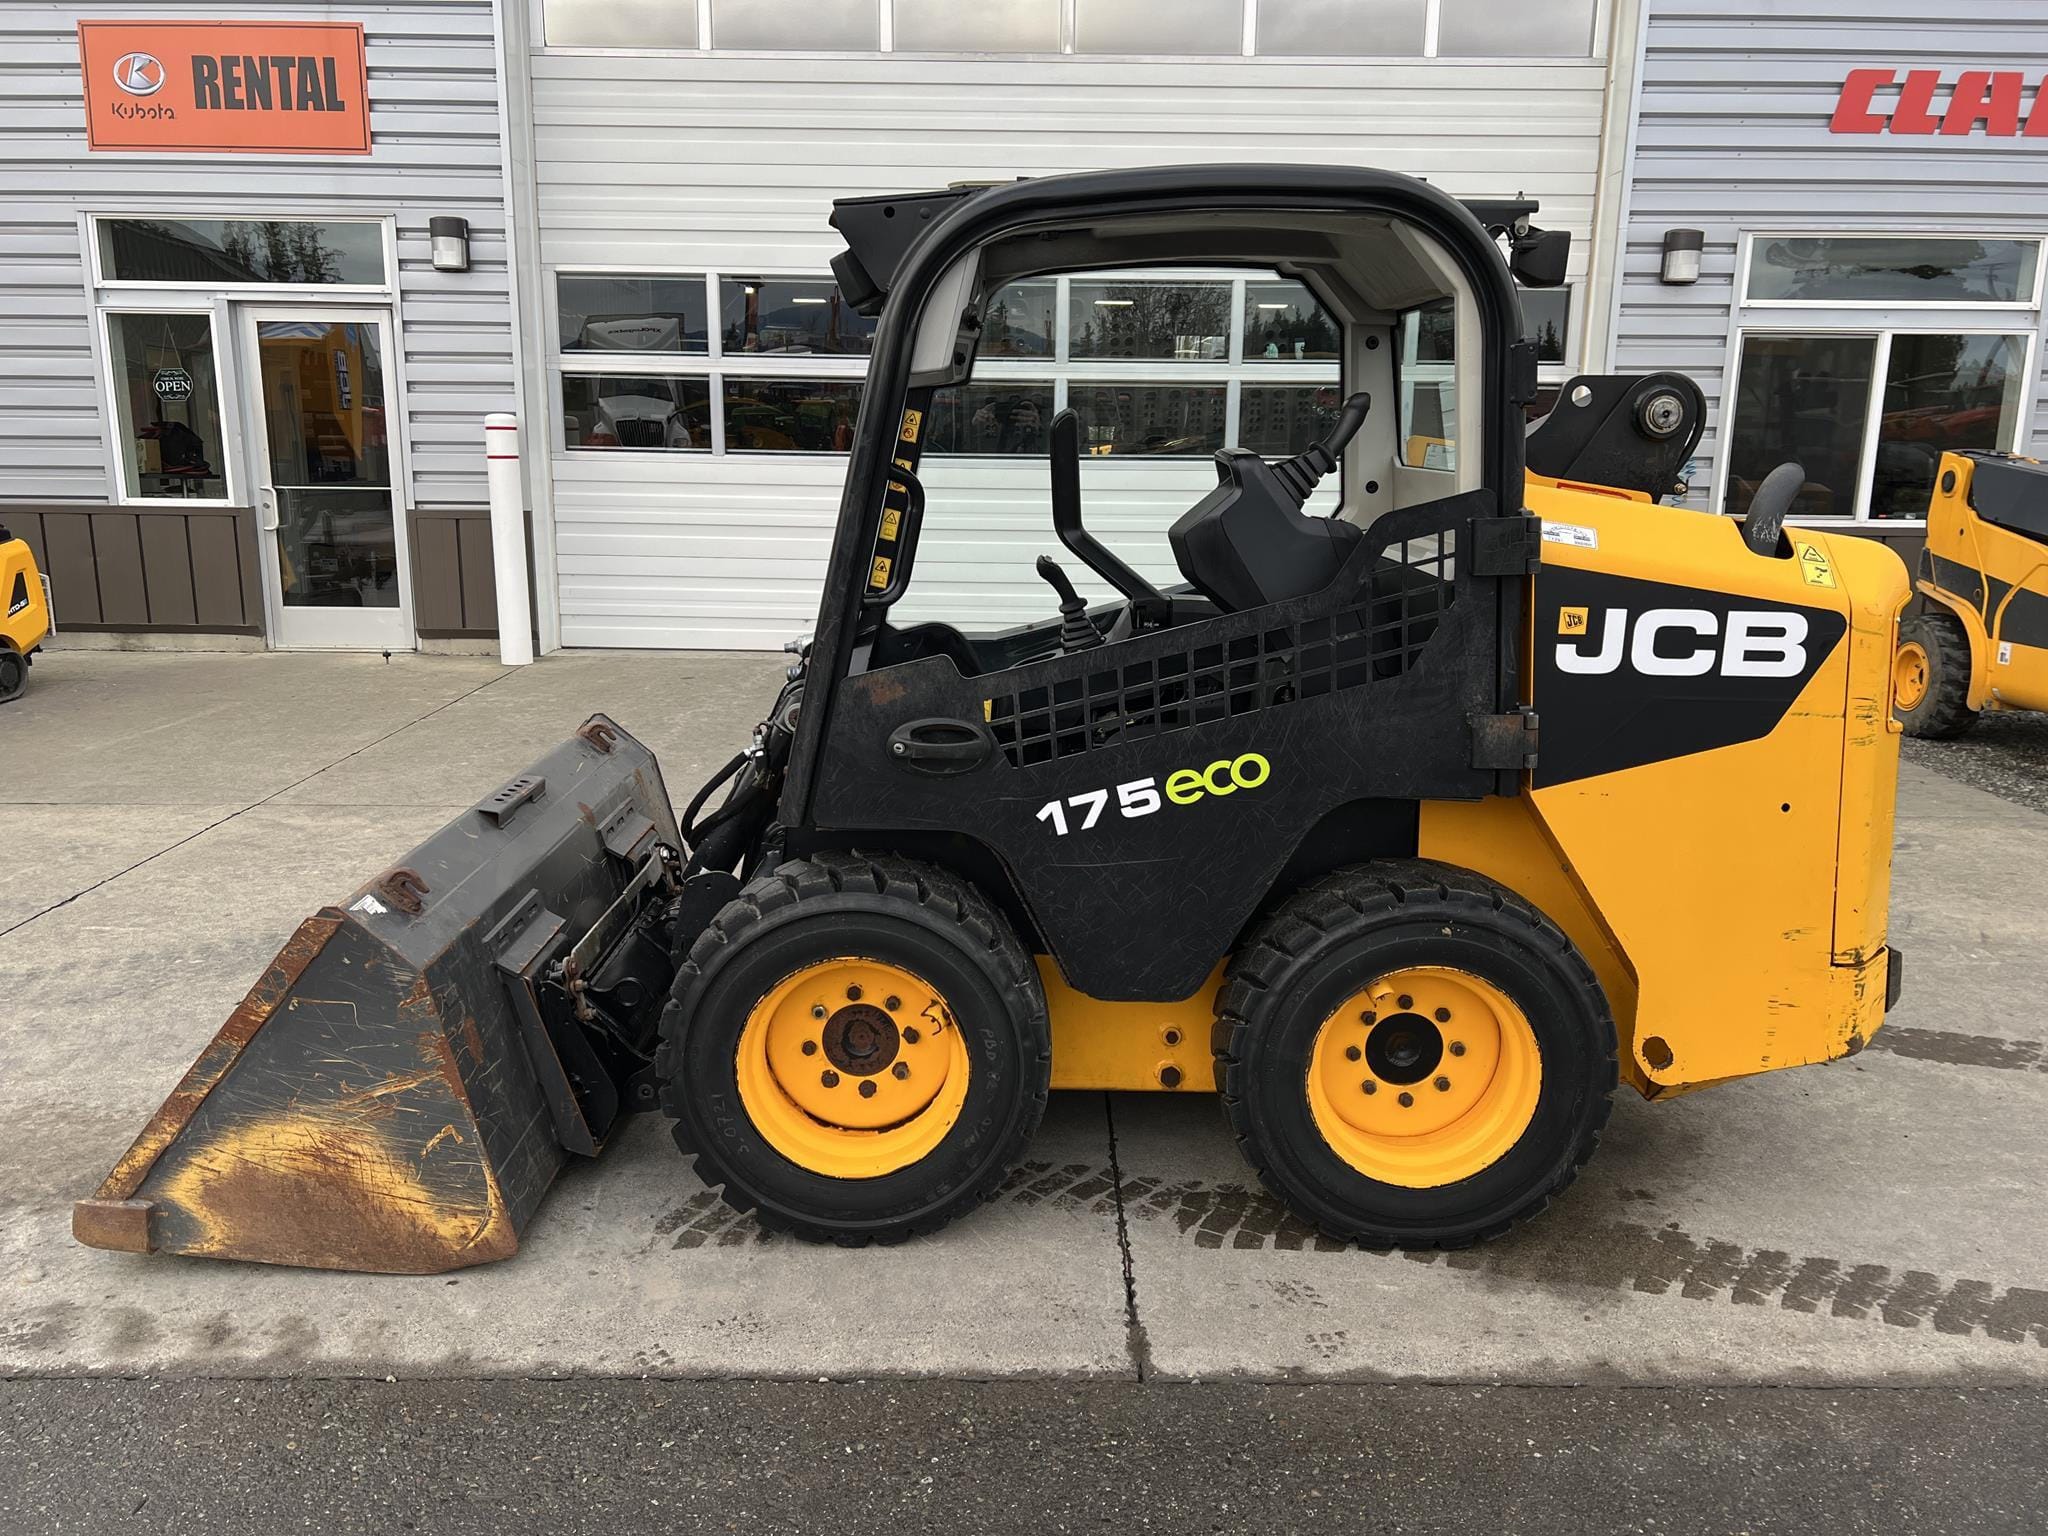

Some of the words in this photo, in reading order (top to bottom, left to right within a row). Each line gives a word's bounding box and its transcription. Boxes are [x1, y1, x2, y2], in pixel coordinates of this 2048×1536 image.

[191, 55, 345, 111] RENTAL
[111, 102, 176, 120] Kubota
[155, 380, 191, 392] OPEN
[1566, 612, 1584, 627] JCB
[1555, 608, 1809, 677] JCB
